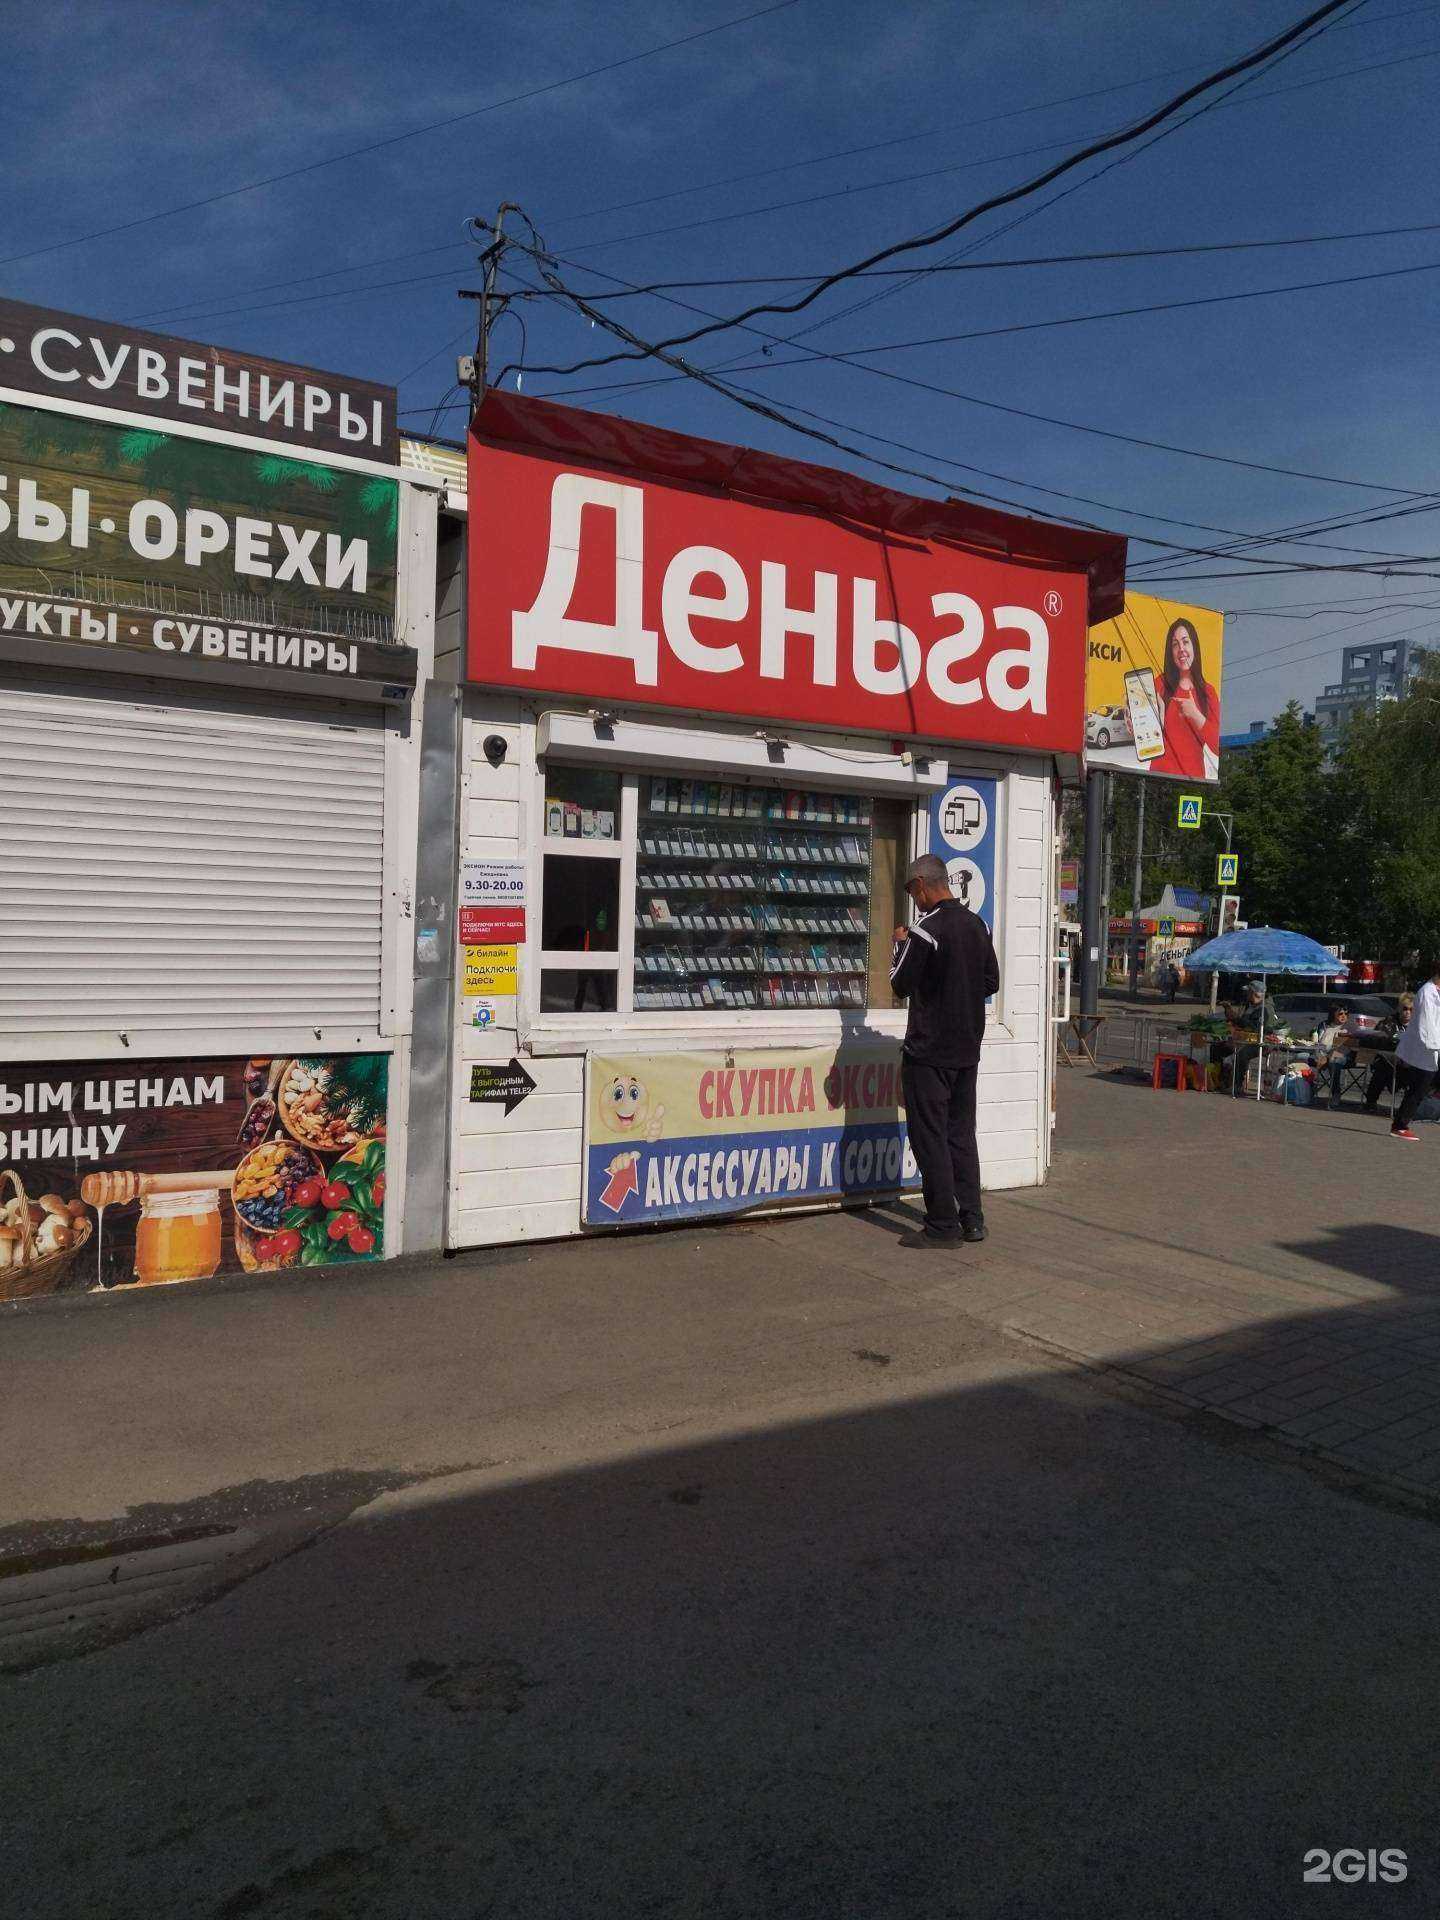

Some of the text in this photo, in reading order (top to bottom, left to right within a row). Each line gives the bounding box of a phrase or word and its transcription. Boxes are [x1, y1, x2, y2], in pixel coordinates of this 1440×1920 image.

[30, 327, 383, 446] СУВЕНИРЫ
[0, 474, 369, 594] Ы ОРЕХИ
[511, 472, 1050, 715] Деньга
[152, 618, 359, 674] СУВЕНИРЫ
[465, 880, 524, 891] 9.30-20.00
[476, 949, 509, 958] билайн
[466, 976, 495, 986] здесь
[84, 1075, 225, 1116] ЦЕНАМ
[471, 1088, 508, 1098] ТАРИФАМ
[477, 1076, 525, 1087] ВЫГОДНЫМ
[699, 1066, 816, 1120] СКУПКА
[644, 1135, 923, 1208] АКСЕССУАРЫ К СОТОВ
